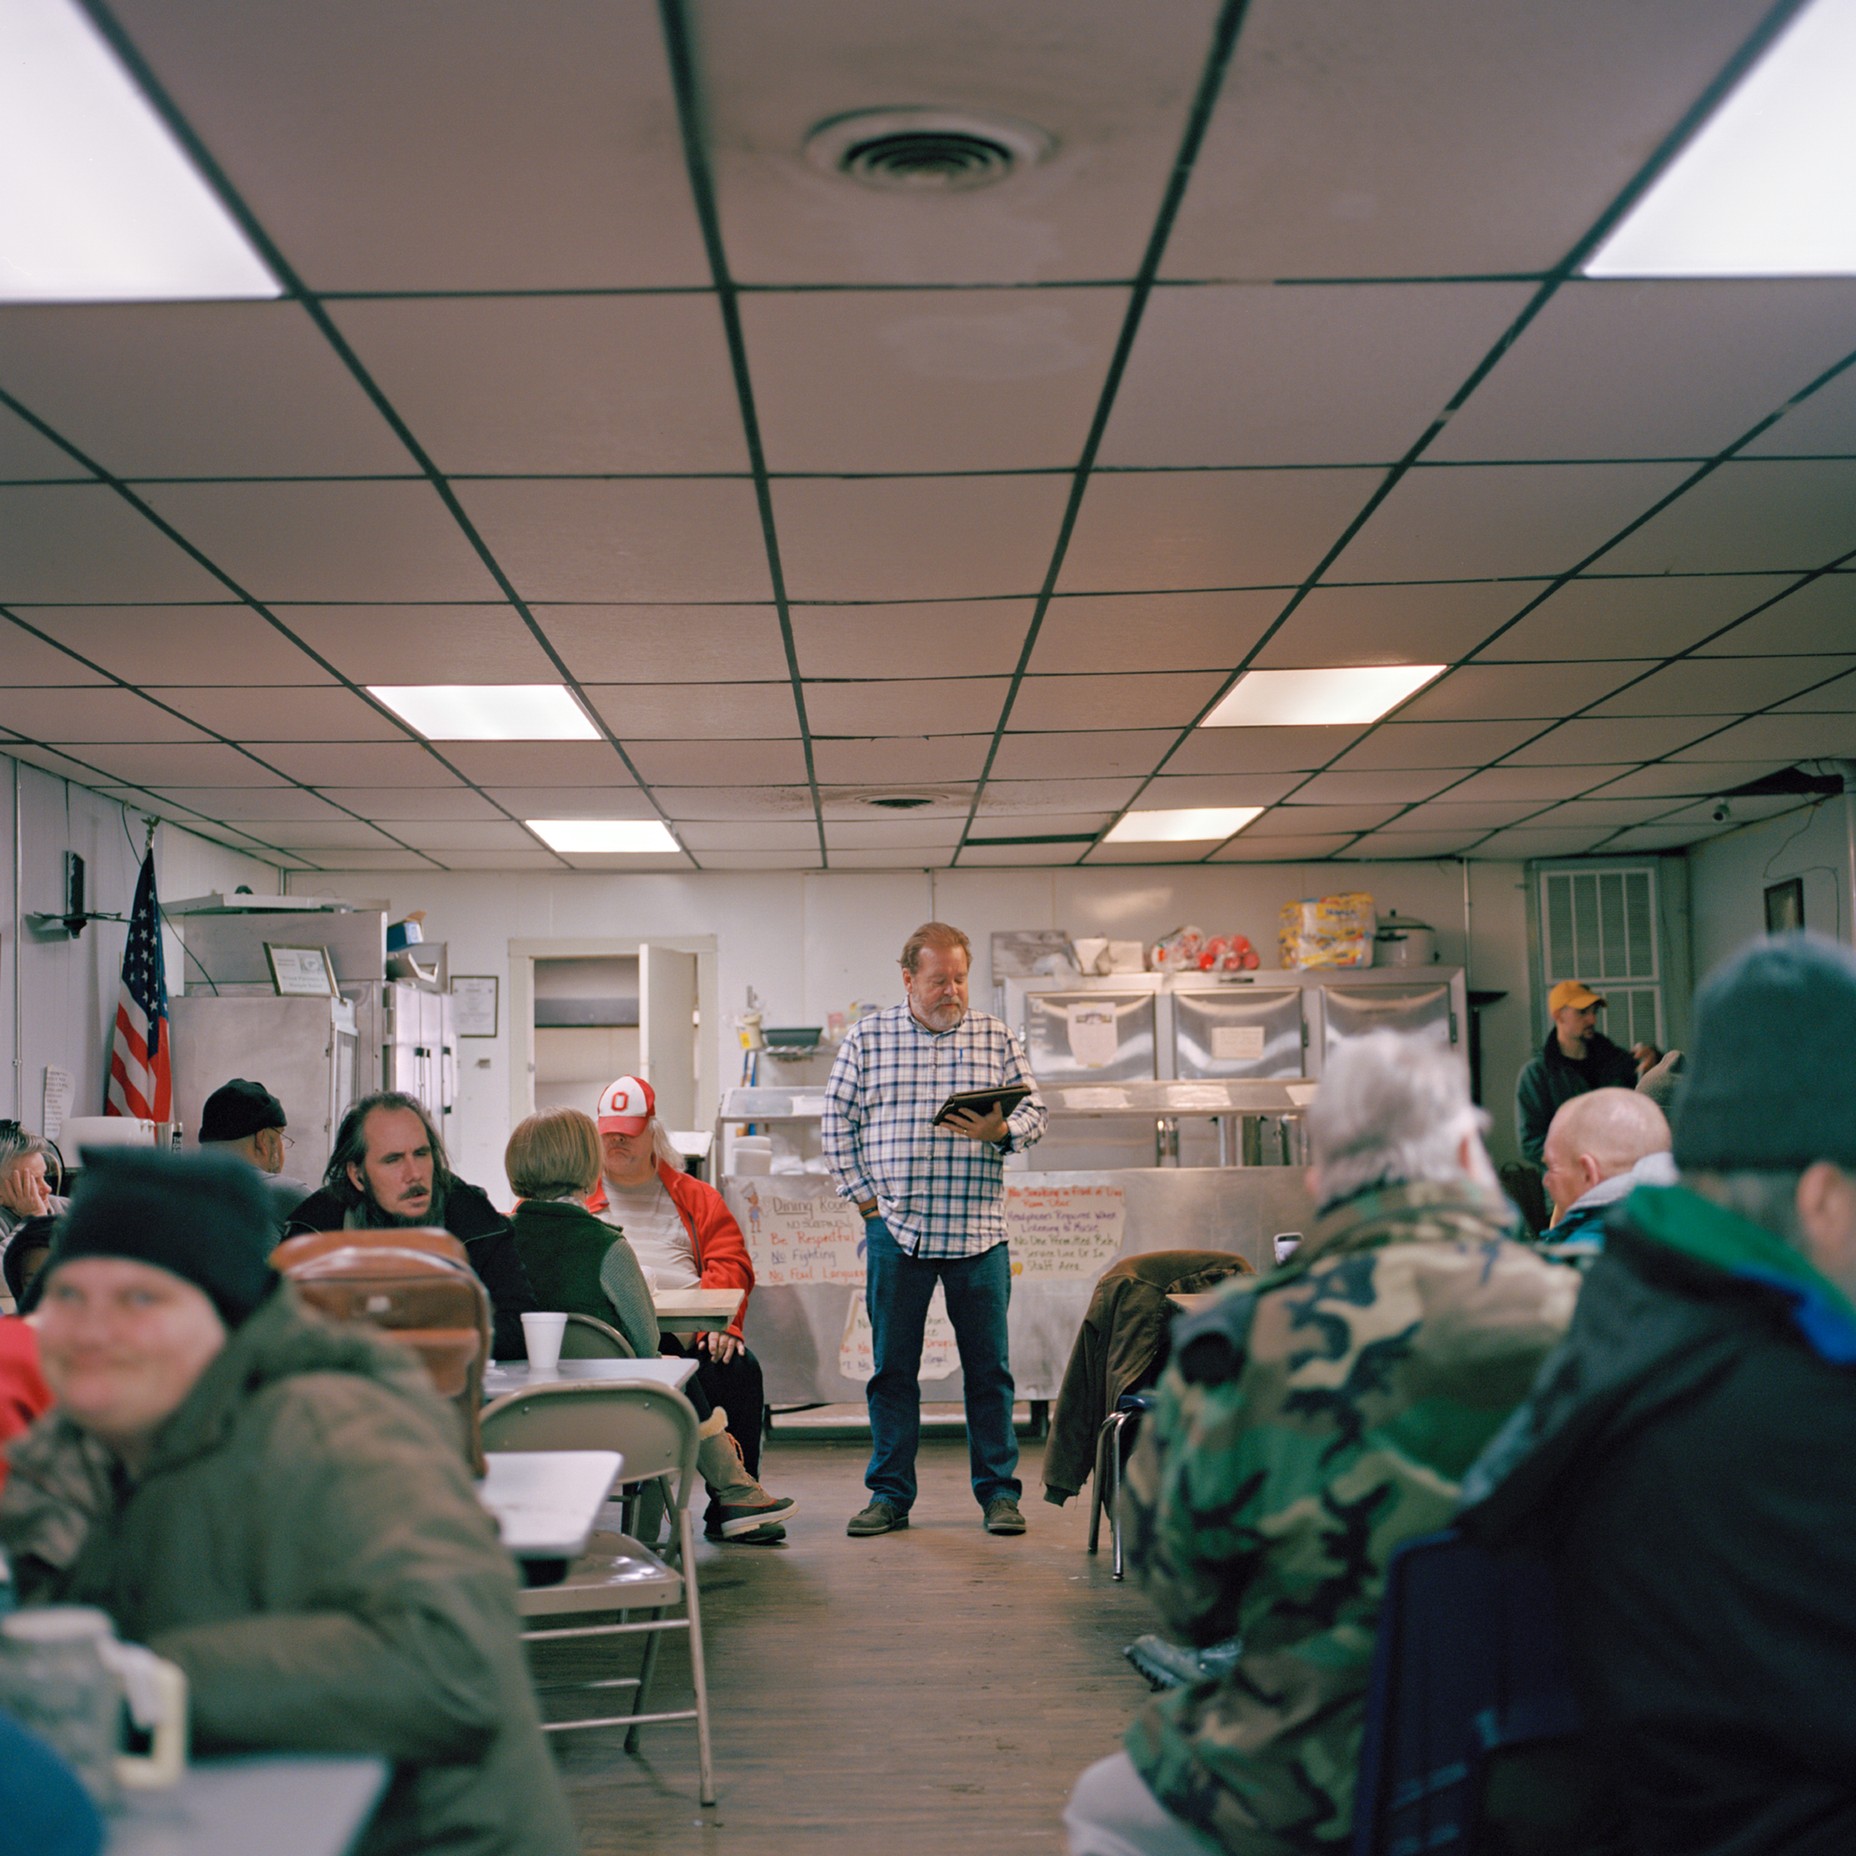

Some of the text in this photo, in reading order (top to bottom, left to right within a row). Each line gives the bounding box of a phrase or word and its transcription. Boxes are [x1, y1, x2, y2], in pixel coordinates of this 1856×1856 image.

[611, 1092, 628, 1112] O
[773, 1197, 814, 1220] Dining
[770, 1232, 788, 1246] Be
[796, 1226, 856, 1249] Respectful
[771, 1249, 786, 1265] No
[792, 1247, 837, 1268] Fighting
[790, 1265, 813, 1279] Foul
[822, 1266, 867, 1284] Languag
